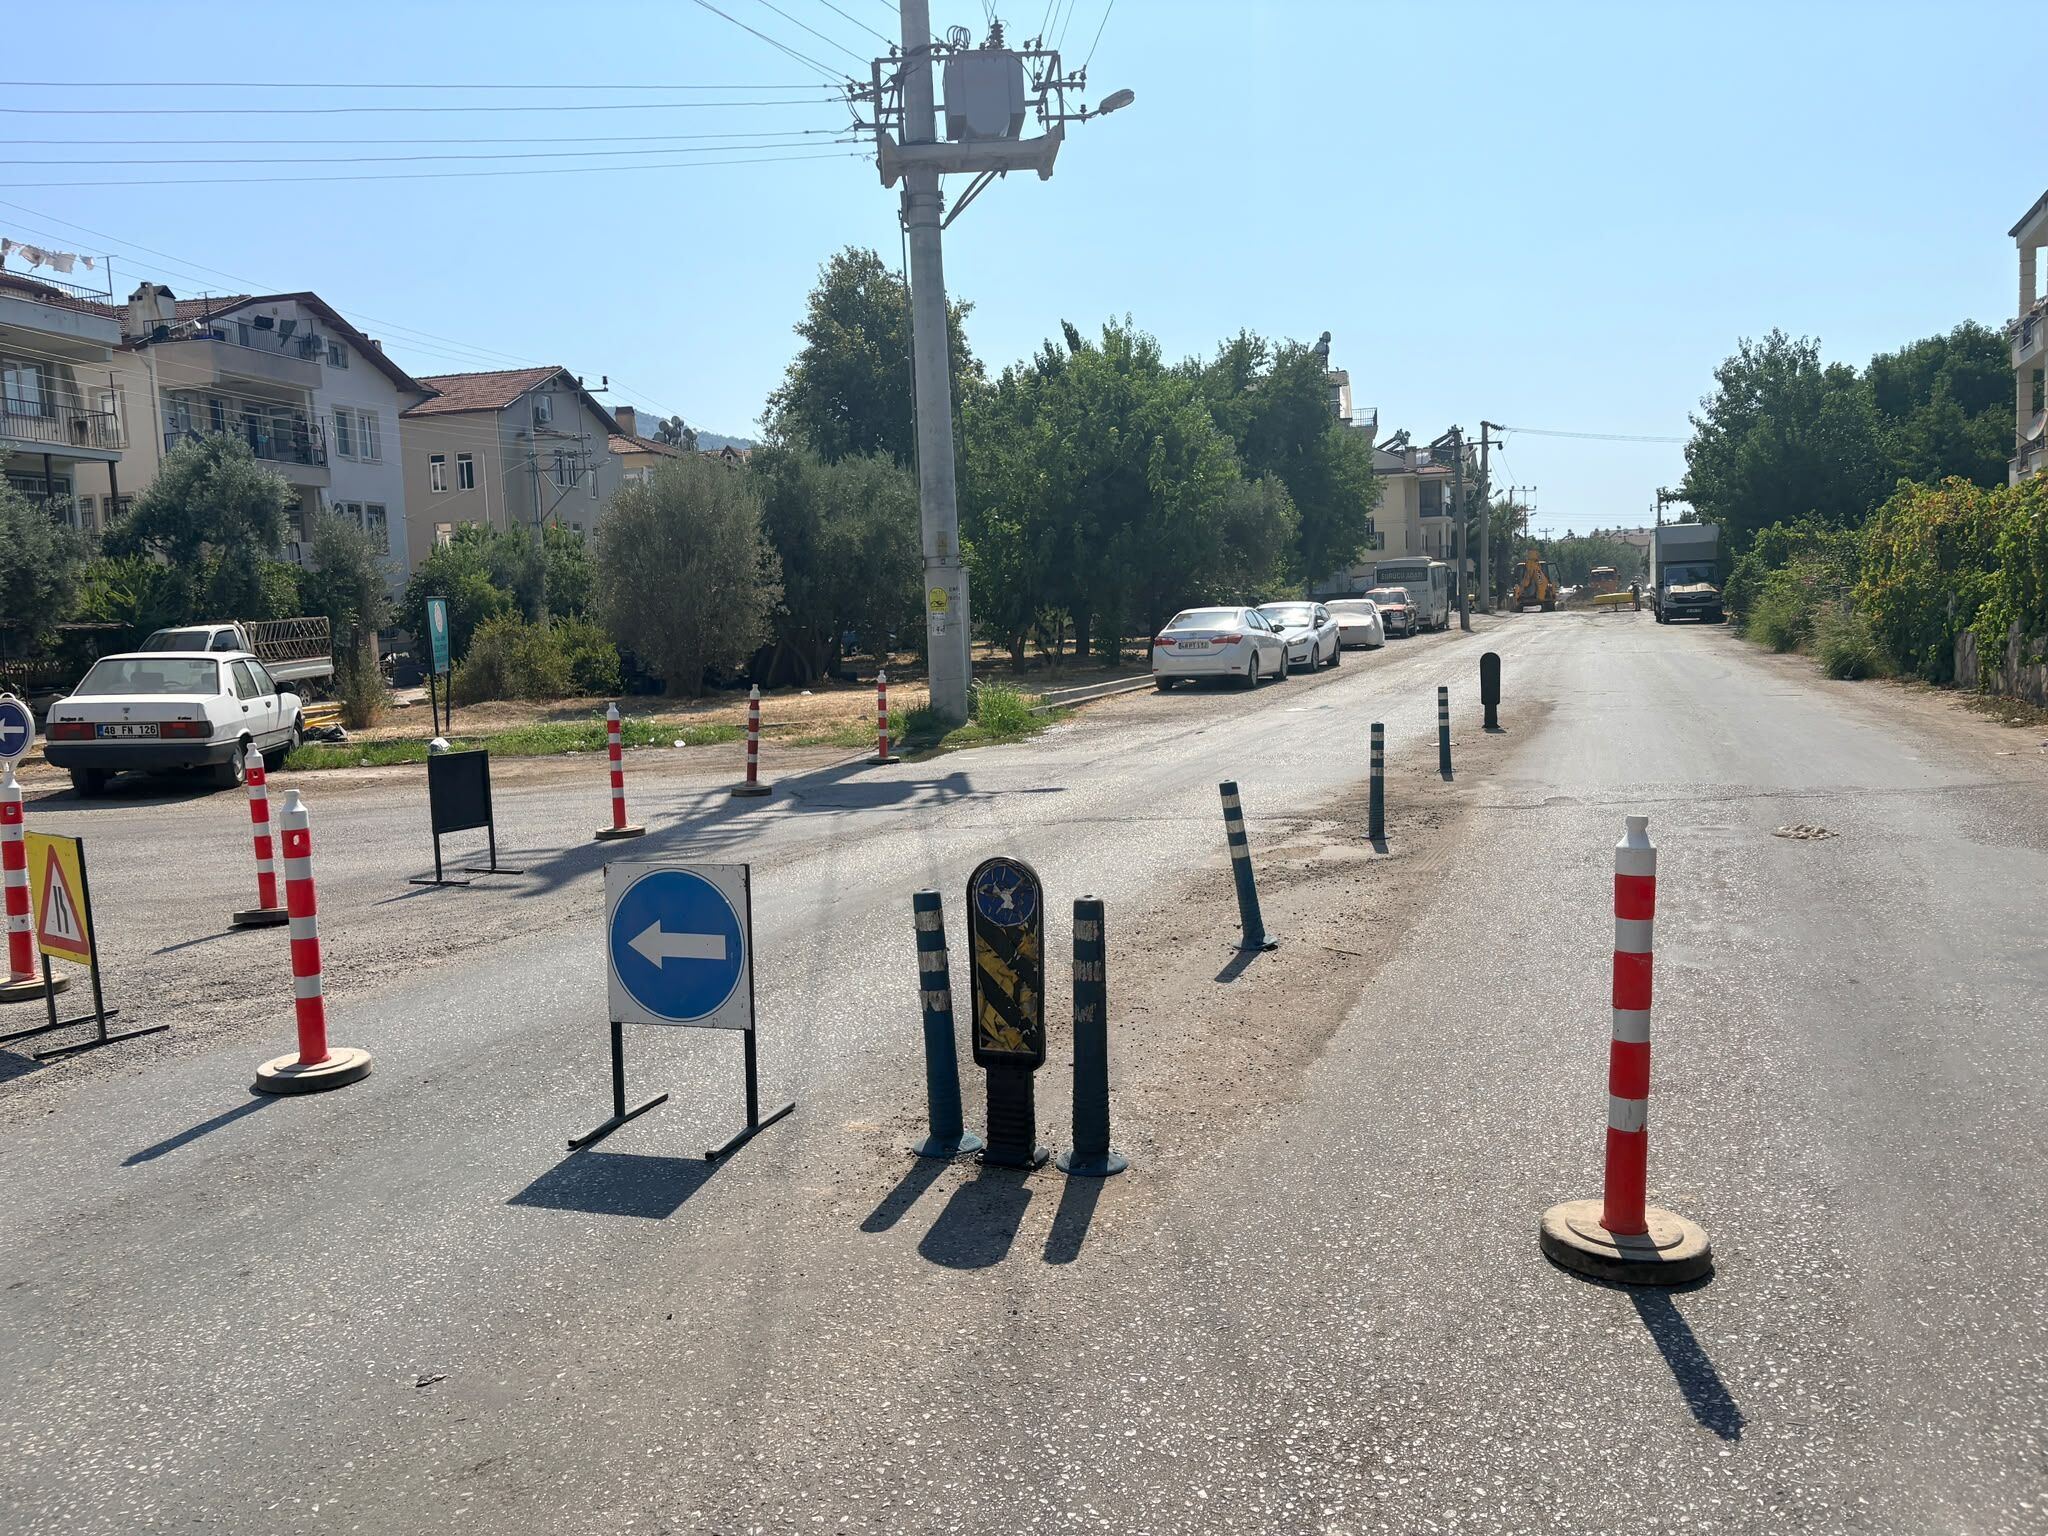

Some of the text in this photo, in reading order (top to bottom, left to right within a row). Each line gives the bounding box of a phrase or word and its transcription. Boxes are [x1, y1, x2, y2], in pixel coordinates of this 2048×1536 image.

[104, 725, 156, 735] 48 FN 126
